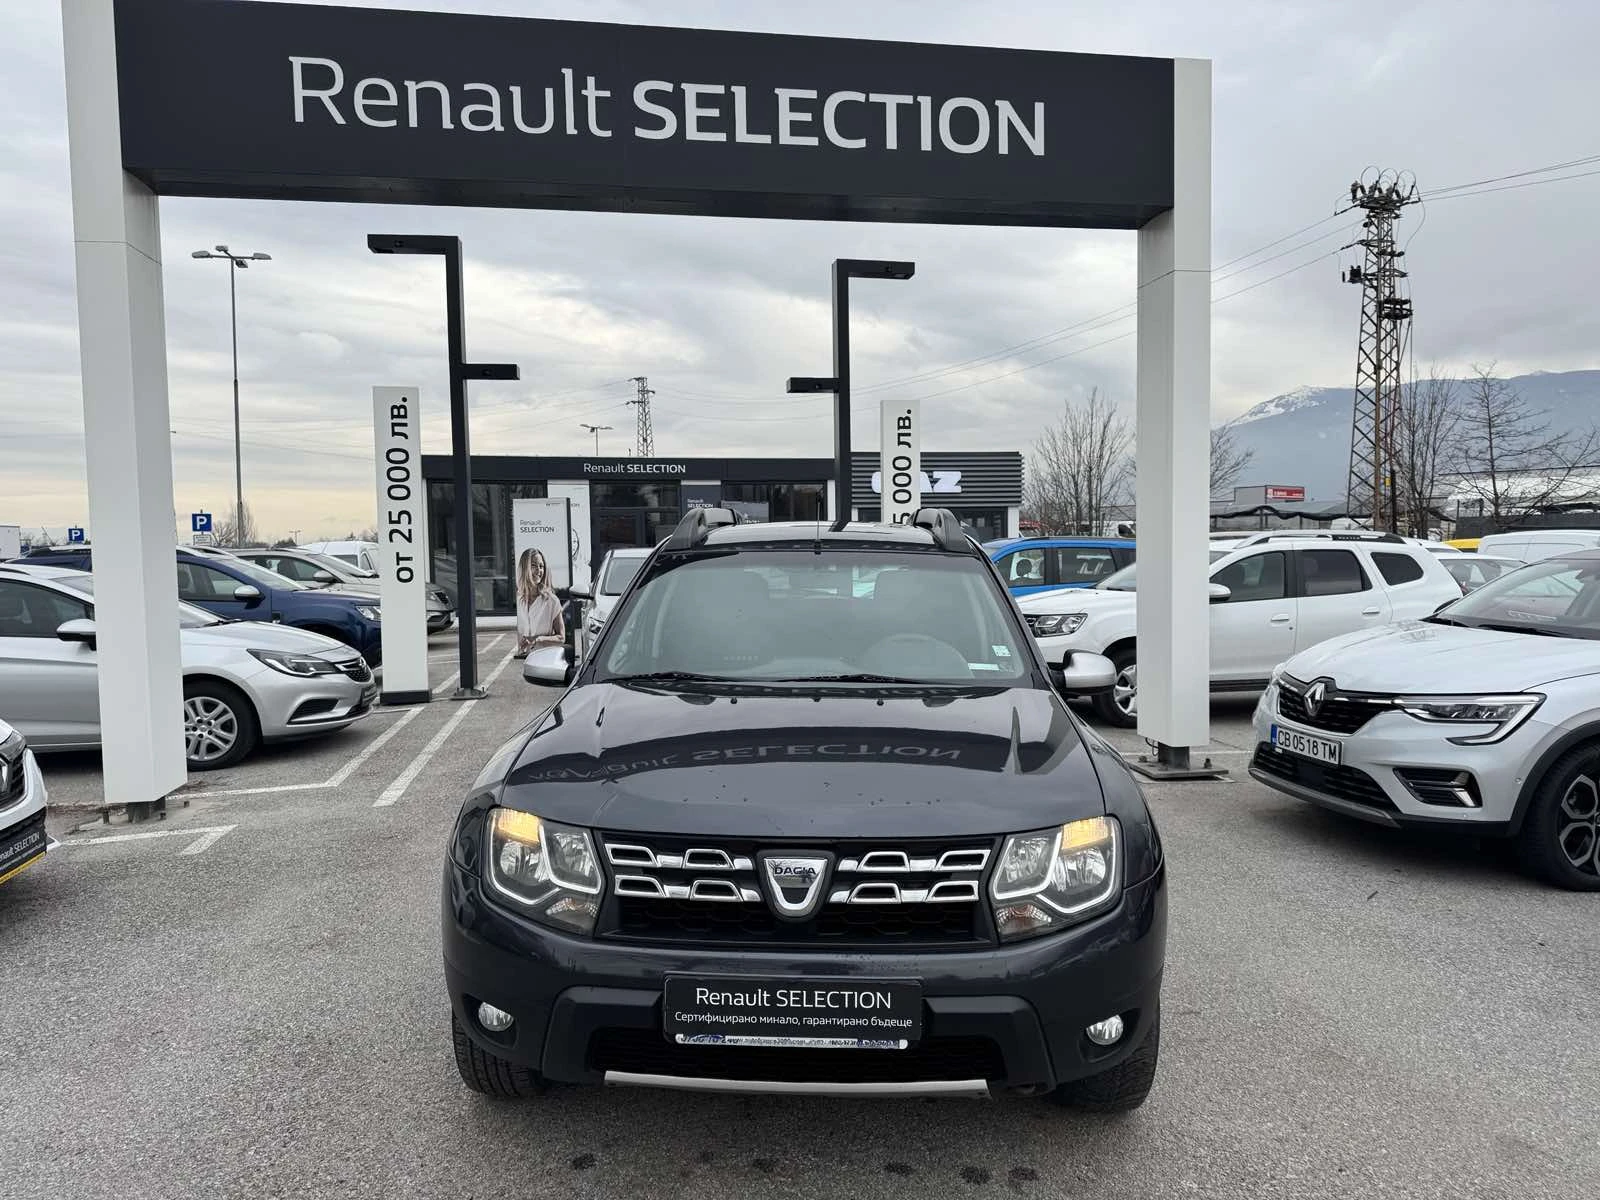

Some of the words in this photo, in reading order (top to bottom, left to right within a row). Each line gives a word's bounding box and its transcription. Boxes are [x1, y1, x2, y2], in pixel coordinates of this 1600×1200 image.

[288, 55, 613, 138] Renault
[632, 79, 1046, 157] SELECTION
[390, 396, 409, 440] лв.
[897, 408, 912, 449] лв.
[385, 447, 411, 501] 000
[583, 463, 625, 474] Renault
[626, 464, 686, 474] SELECTION
[892, 455, 912, 505] 000
[71, 529, 81, 541] P
[196, 515, 207, 530] P
[387, 509, 413, 544] 25
[519, 526, 555, 534] SELECTION
[395, 551, 414, 584] от
[1278, 730, 1291, 748] CB
[1292, 734, 1319, 756] 0518
[1321, 741, 1337, 762] TM
[14, 831, 40, 854] SELECTION
[774, 866, 817, 875] DACIA
[695, 987, 772, 1007] Renault
[776, 989, 892, 1009] SELECTION
[674, 1011, 758, 1025] Сертифицирано
[759, 1015, 801, 1026] минало,
[802, 1016, 869, 1028] гарантирано
[870, 1016, 913, 1028] бъдеще
